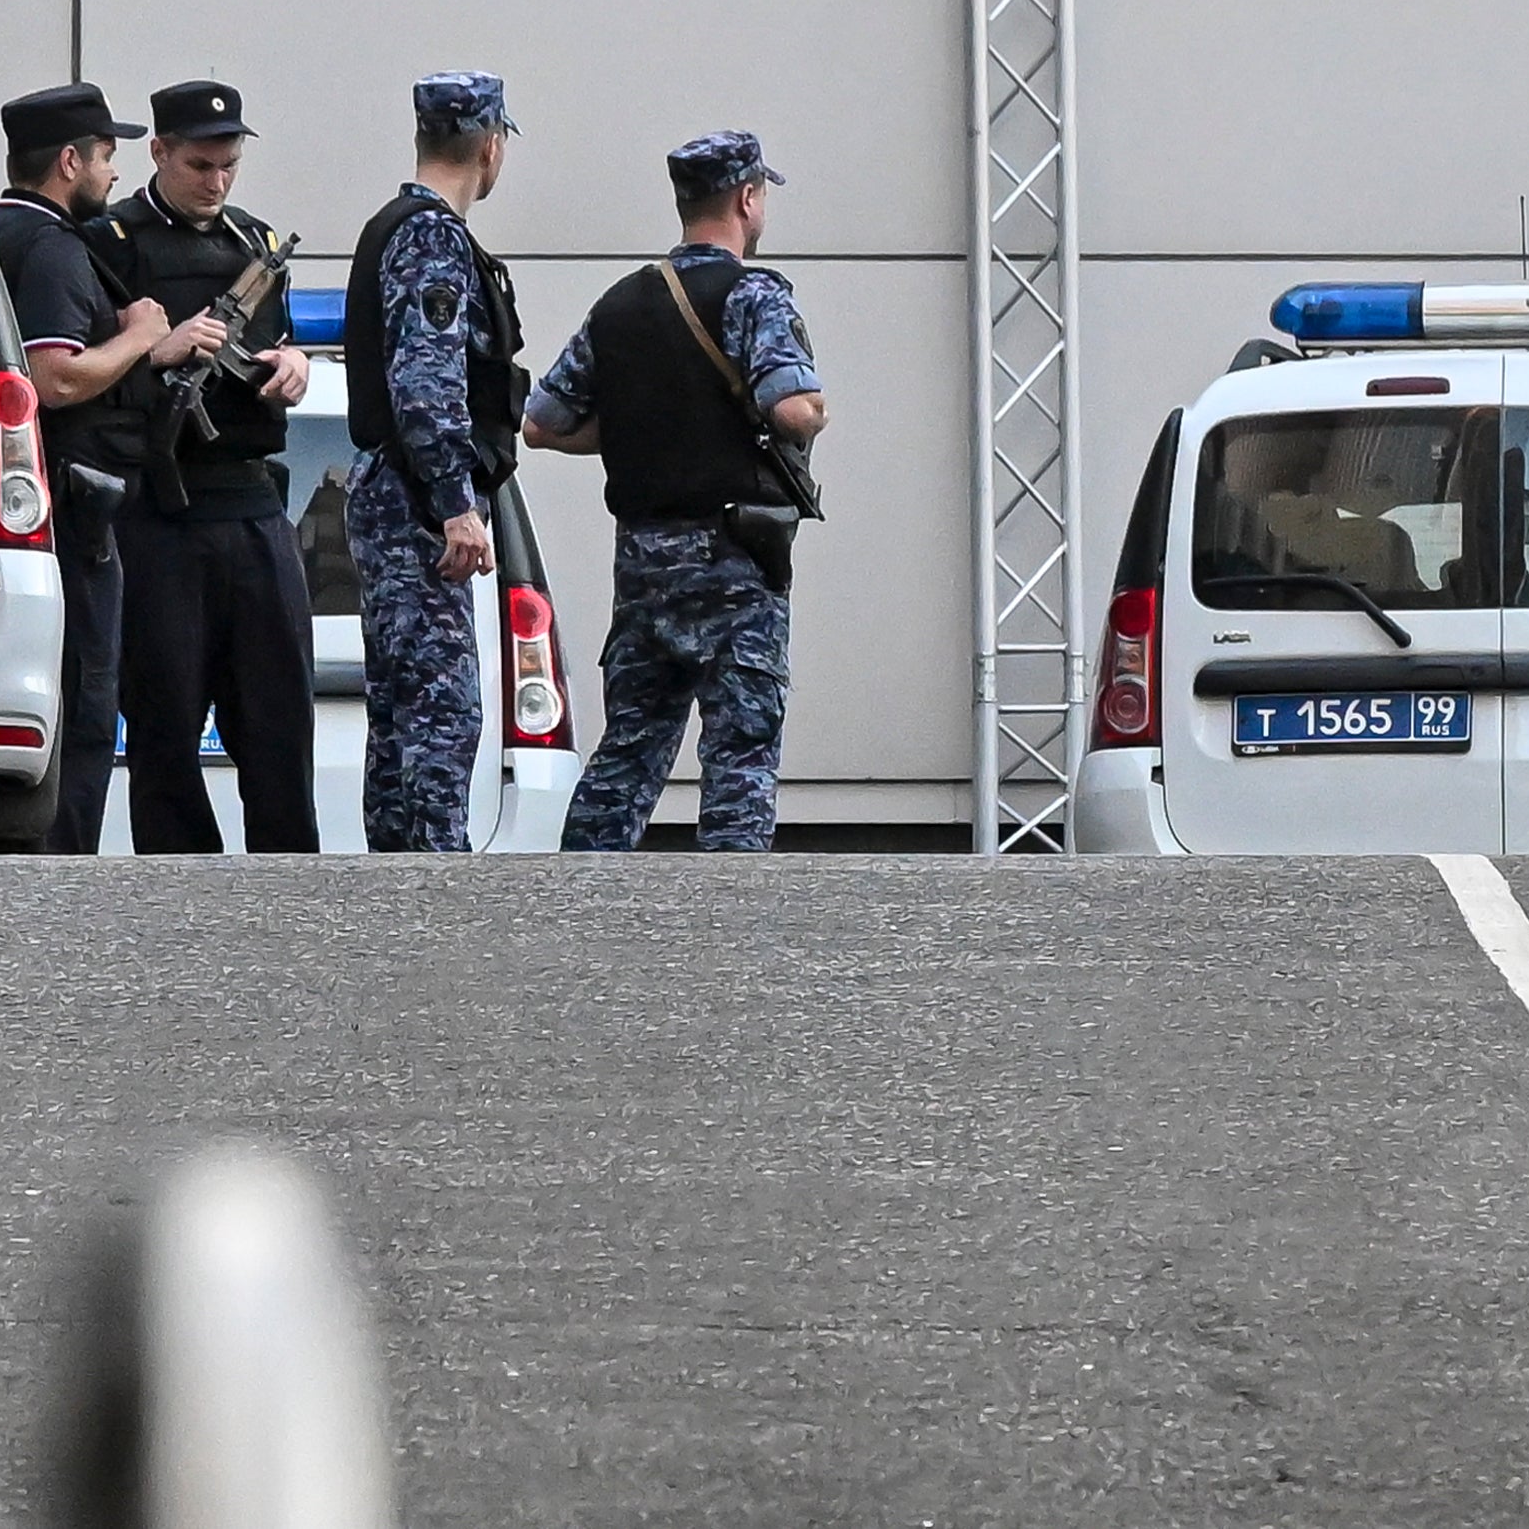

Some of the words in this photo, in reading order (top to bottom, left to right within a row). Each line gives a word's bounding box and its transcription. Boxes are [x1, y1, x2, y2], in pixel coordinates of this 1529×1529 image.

[1297, 699, 1392, 735] 1565
[1418, 696, 1456, 724] 99
[1422, 725, 1450, 736] RUS
[200, 739, 225, 749] RU
